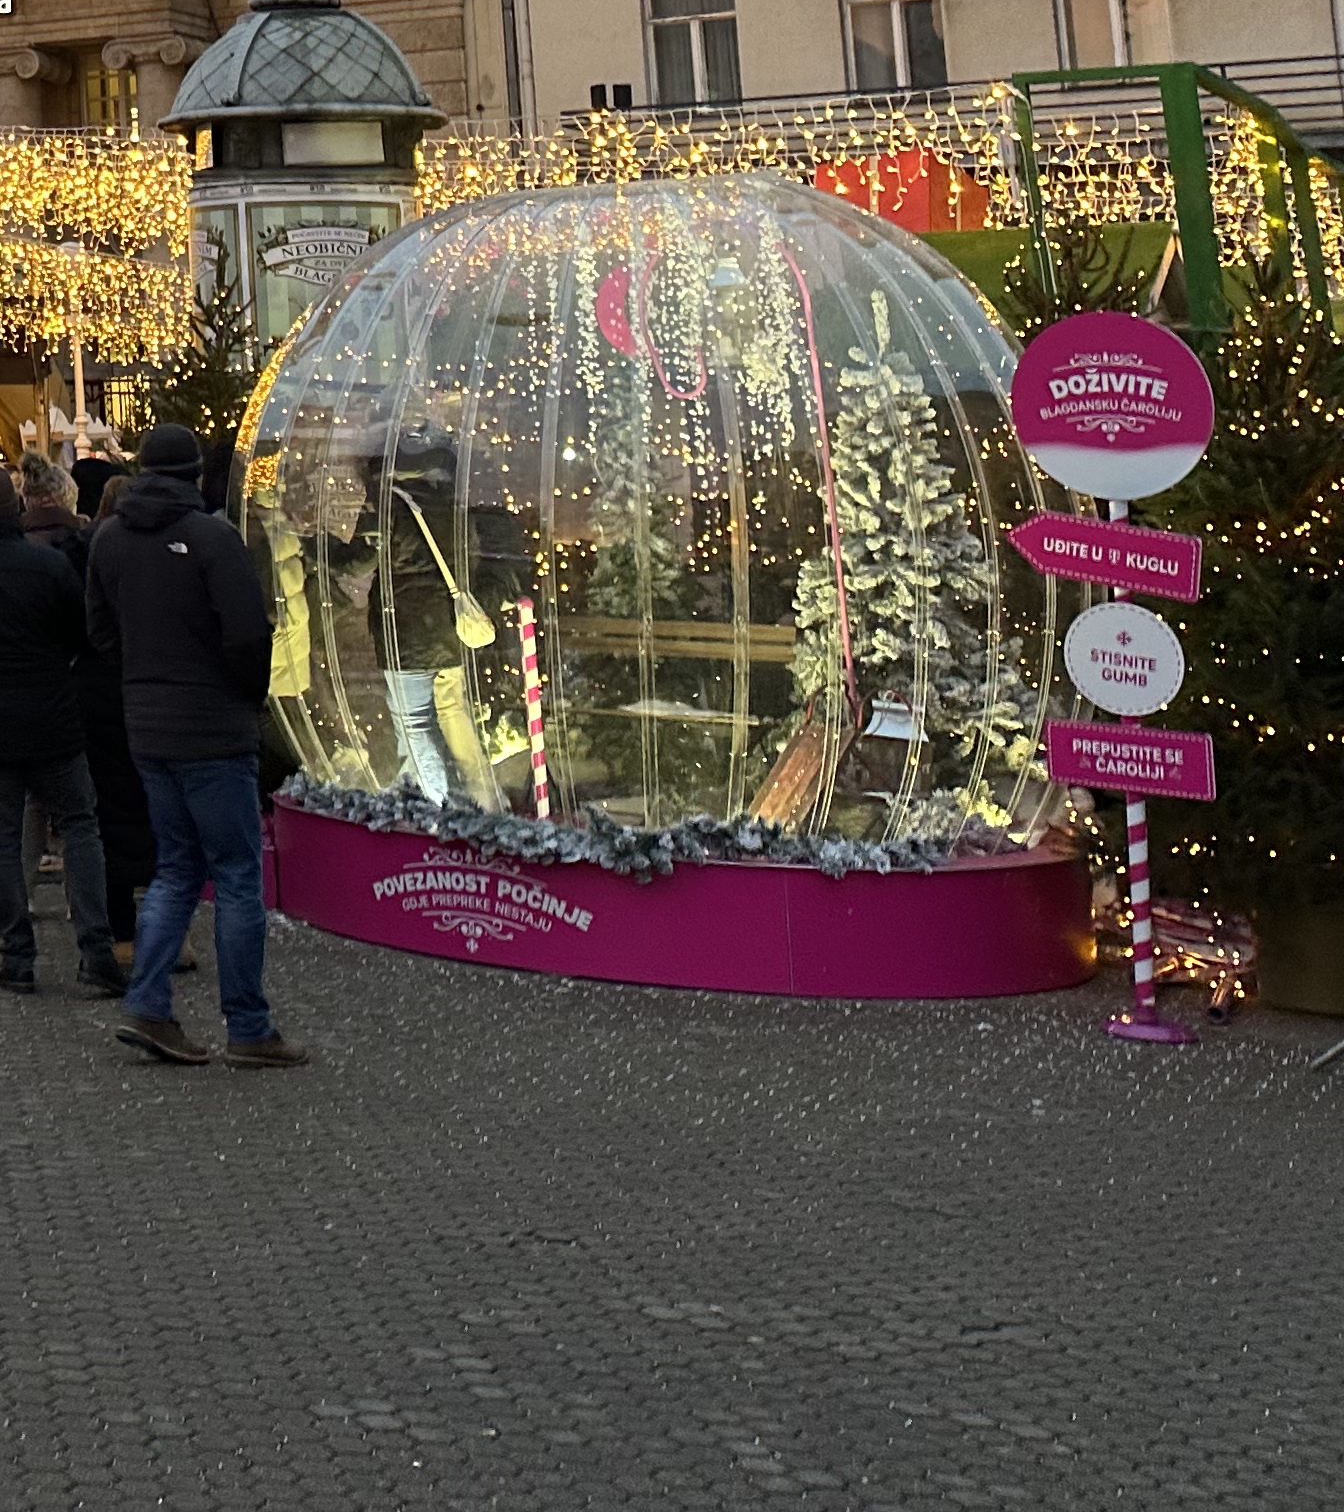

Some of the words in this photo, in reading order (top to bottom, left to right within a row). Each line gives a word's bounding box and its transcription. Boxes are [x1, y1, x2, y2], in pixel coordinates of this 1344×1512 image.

[281, 241, 368, 259] NEOBIČNI
[1048, 367, 1169, 402] DOŽIVITE
[1039, 398, 1119, 421] BLAGDANSKU
[1120, 397, 1182, 423] ČAROLIJU
[1043, 536, 1089, 560] UĐITE
[1091, 543, 1103, 561] U
[1126, 551, 1179, 577] KUGLU
[1089, 647, 1158, 672] STISNITE
[1101, 666, 1148, 688] GUMB
[1072, 737, 1162, 764] PREPUSTITE
[1164, 747, 1184, 766] SE
[372, 869, 491, 902] POVEZANOST
[496, 879, 594, 933] POČINJE
[401, 895, 430, 913] GDJE
[431, 893, 492, 913] PREPREKE
[493, 900, 554, 934] NESTAJU
